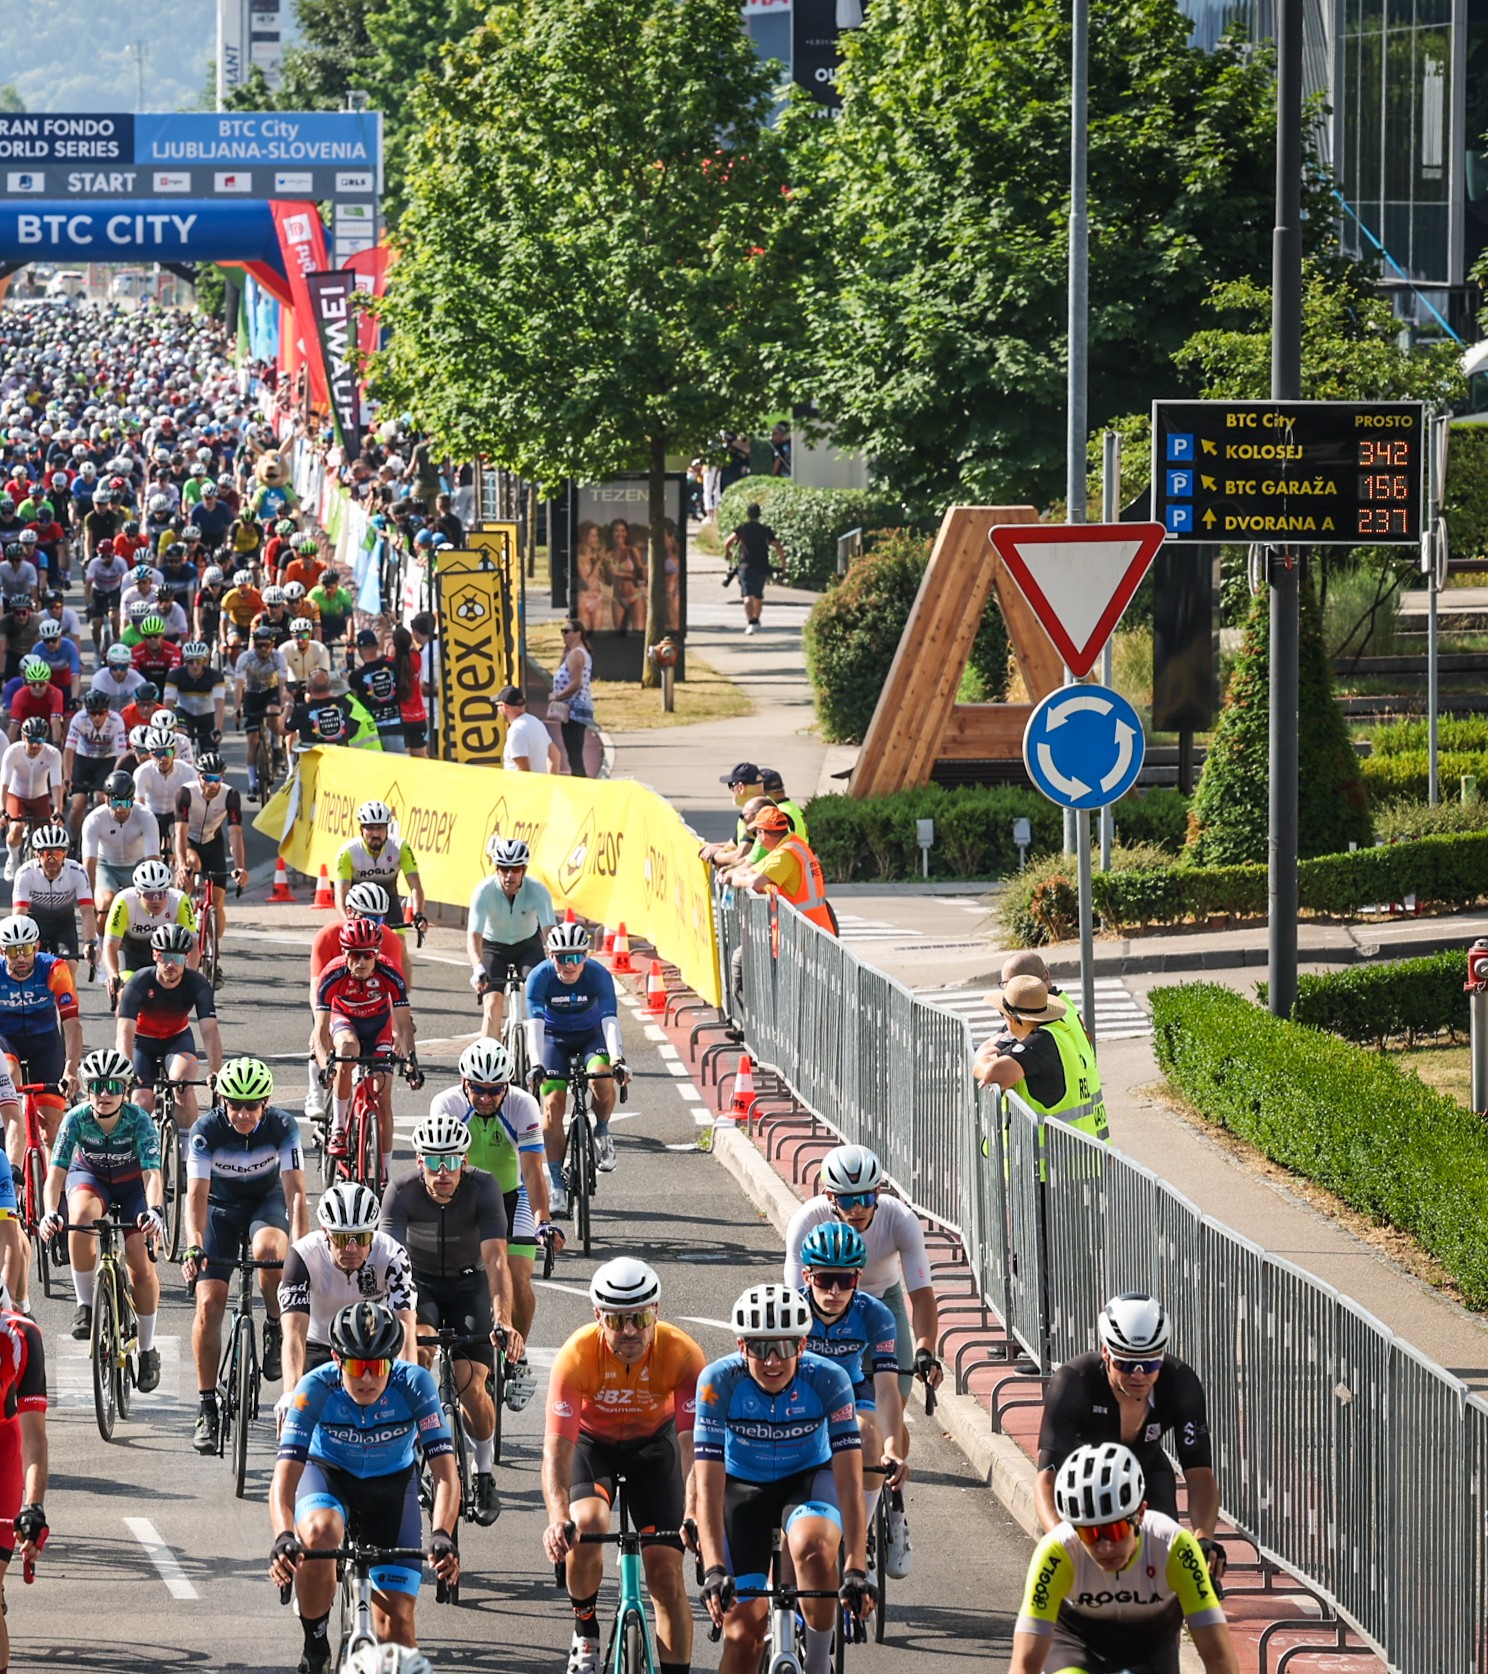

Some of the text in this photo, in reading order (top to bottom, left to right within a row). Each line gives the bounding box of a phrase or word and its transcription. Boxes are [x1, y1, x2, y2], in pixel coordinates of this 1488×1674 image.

[44, 119, 114, 136] FONDO
[219, 119, 299, 142] BTC City
[54, 141, 119, 158] SERIES
[152, 142, 367, 160] LJUBLJANA-SLOVENIA
[67, 173, 136, 192] START
[18, 214, 197, 244] BTC CITY
[319, 286, 354, 430] HUAWEI
[1226, 413, 1296, 430] BTC City
[1355, 416, 1413, 427] PROSTO
[1174, 439, 1303, 460] P KOLOSEJ
[1359, 441, 1408, 466] 342
[1225, 481, 1256, 494] BTC
[1262, 476, 1337, 495] GARAŽA
[1364, 475, 1407, 499] 156
[1173, 510, 1335, 530] P DVORANA A
[1358, 509, 1407, 533] 237
[215, 1156, 274, 1173] KOLEKTOR
[1073, 1590, 1164, 1607] ROGLA
